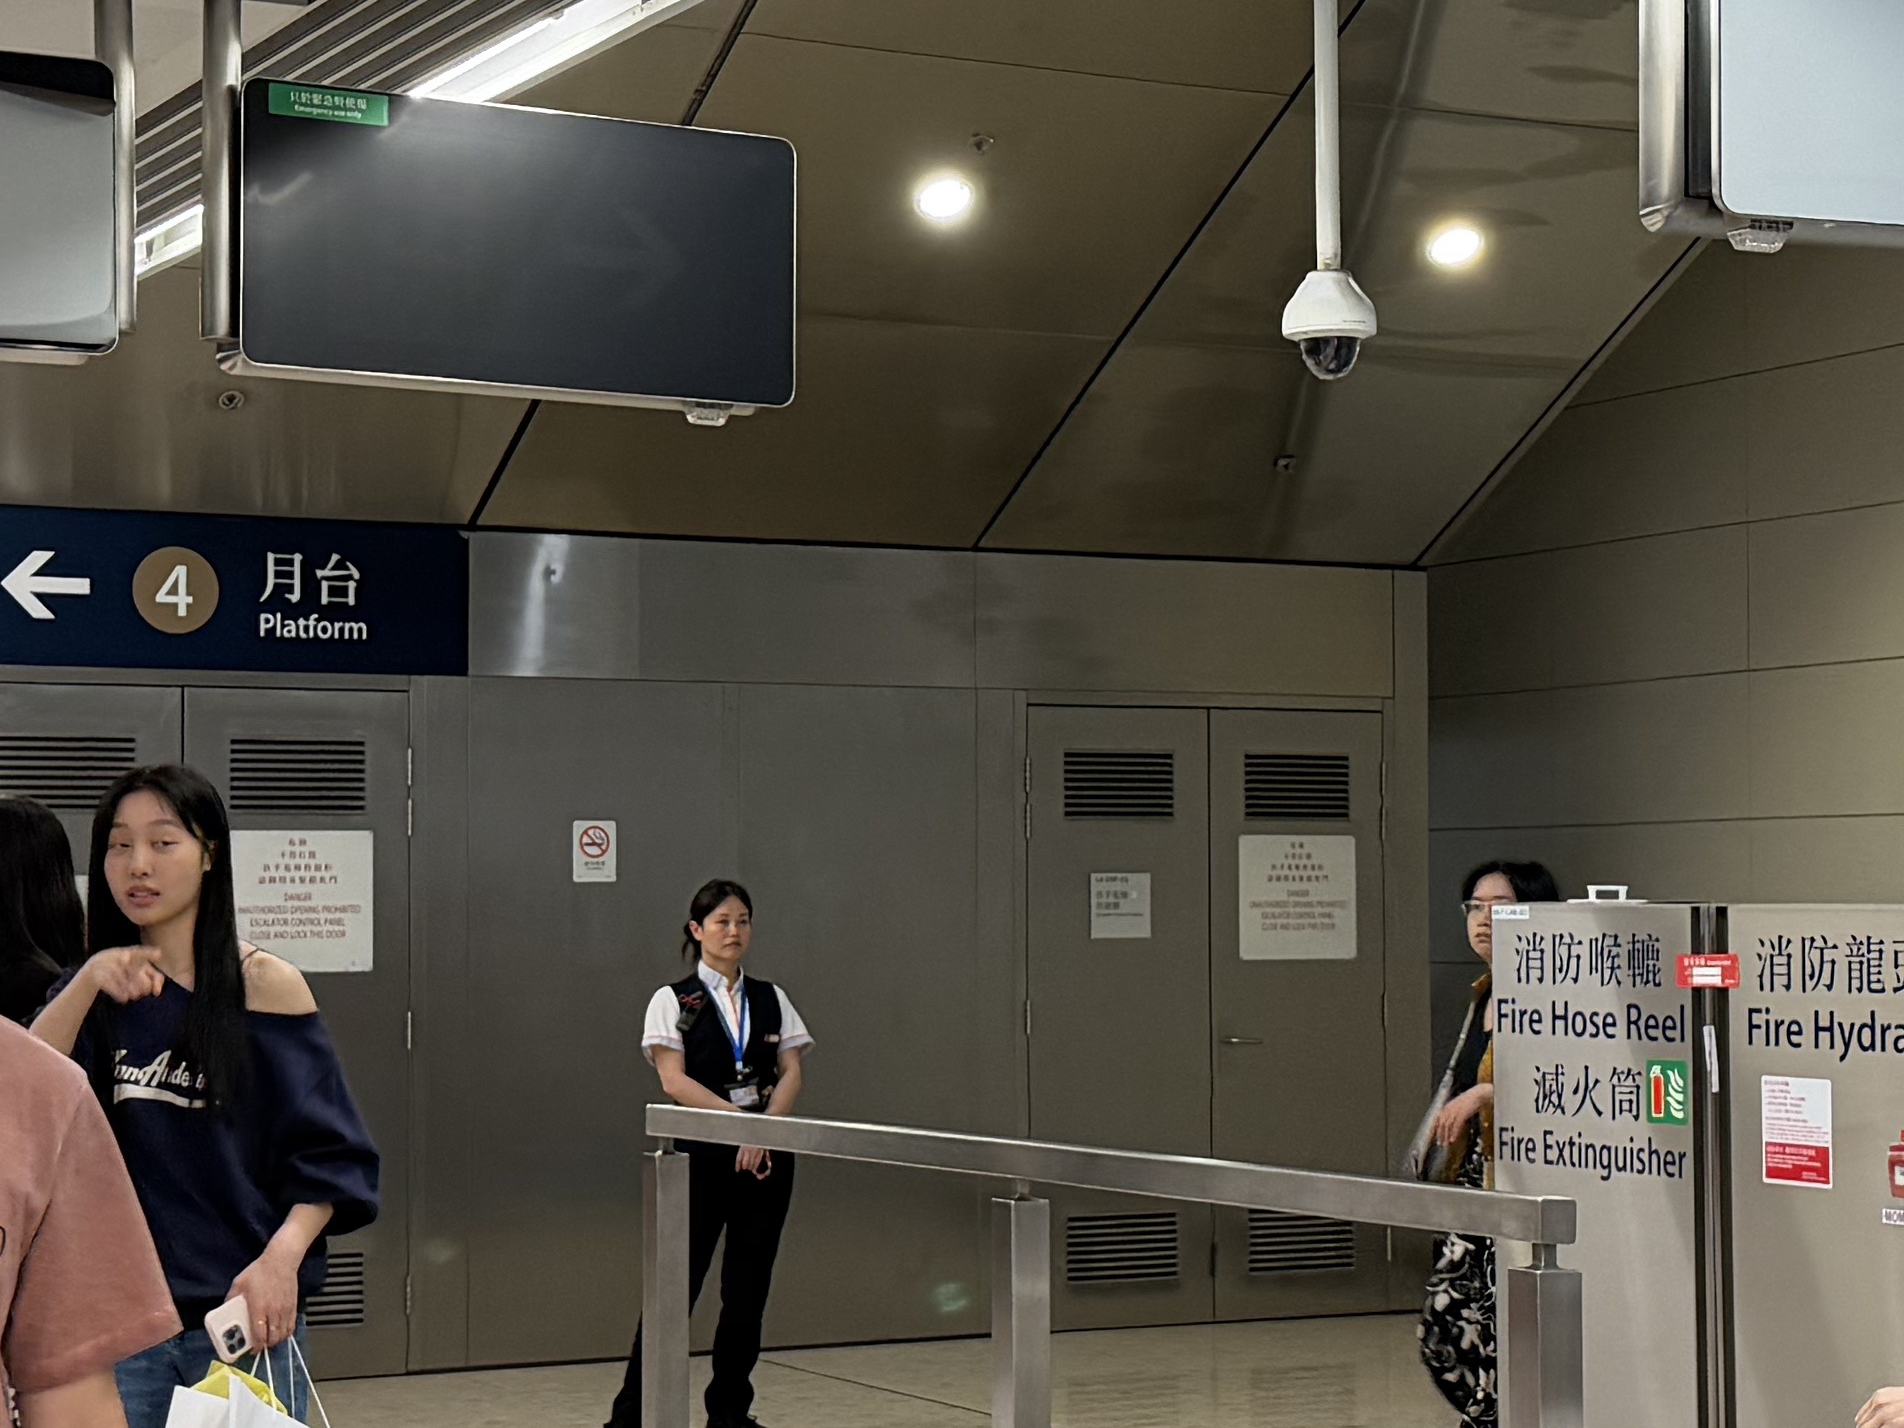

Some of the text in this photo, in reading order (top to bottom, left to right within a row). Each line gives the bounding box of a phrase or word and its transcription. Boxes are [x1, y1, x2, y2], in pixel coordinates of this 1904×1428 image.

[155, 564, 194, 617] 4
[259, 551, 361, 606] 月台
[259, 613, 368, 640] Platform
[1515, 932, 1662, 988] 消防喉轆
[1496, 998, 1686, 1044] Fire Hose Reel
[1746, 1007, 1804, 1048] Fire
[1534, 1063, 1642, 1123] 滅火筒
[1498, 1126, 1687, 1182] Fire Extinguisher
